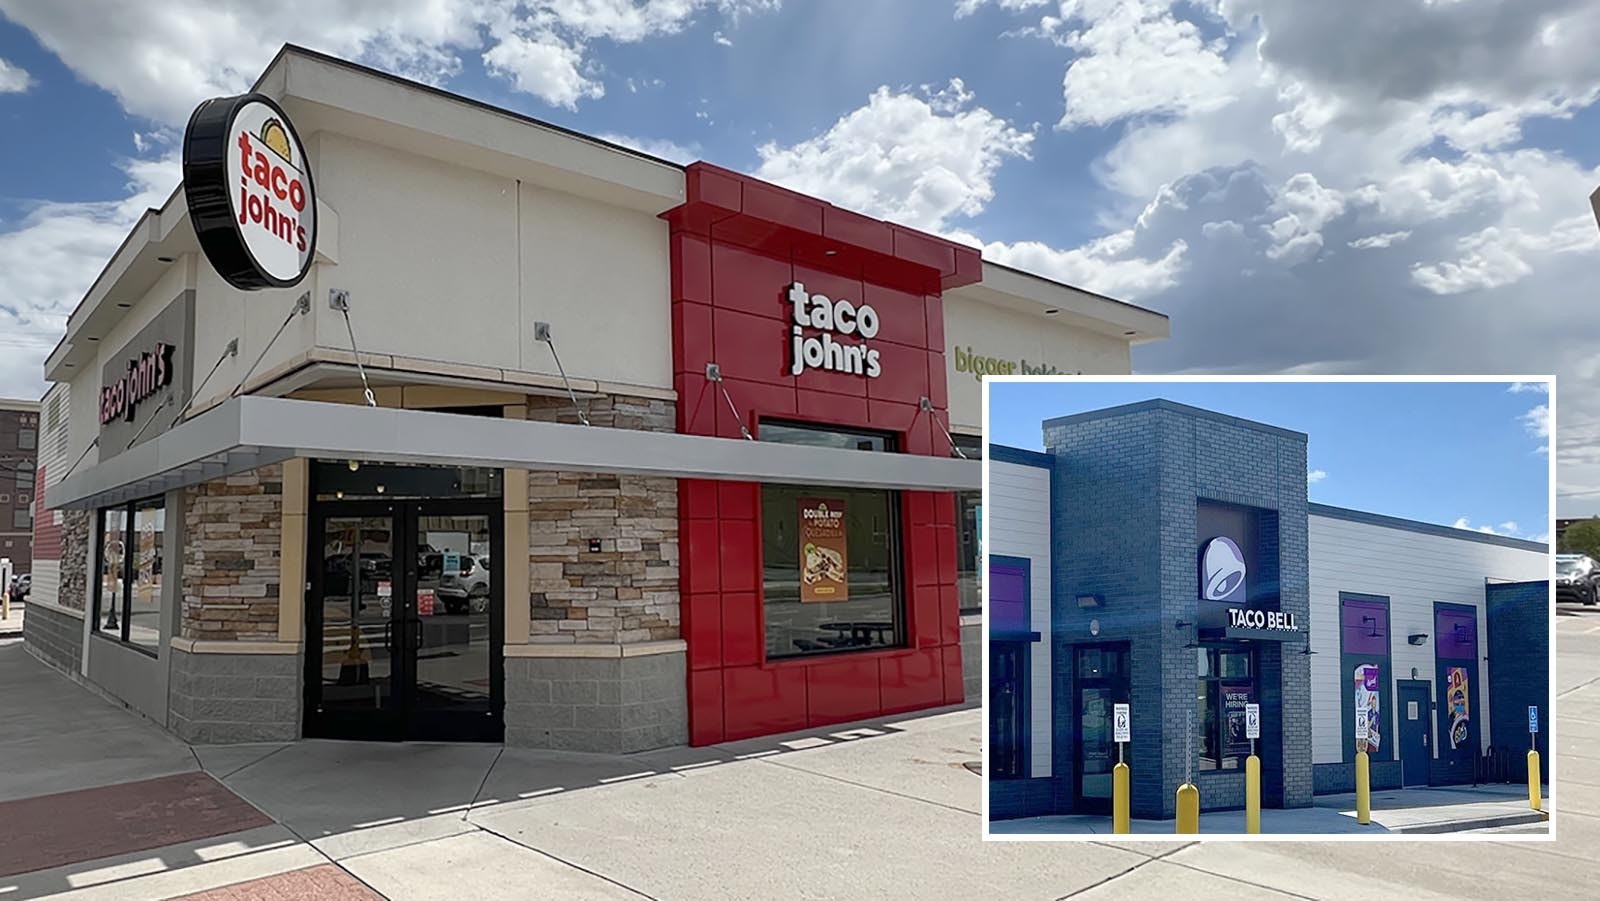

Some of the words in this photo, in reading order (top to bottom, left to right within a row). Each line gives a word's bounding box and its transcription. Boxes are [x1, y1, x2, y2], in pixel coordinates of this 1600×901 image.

[238, 131, 306, 212] taco
[239, 176, 307, 252] john's
[789, 281, 880, 339] taco
[791, 324, 881, 378] john's
[954, 346, 1017, 381] bigger
[98, 378, 126, 425] taco
[124, 343, 171, 422] john's
[1228, 608, 1265, 628] TACO
[1267, 611, 1299, 630] BELL
[1225, 693, 1248, 701] WE'RE
[1225, 700, 1249, 709] HIRING
